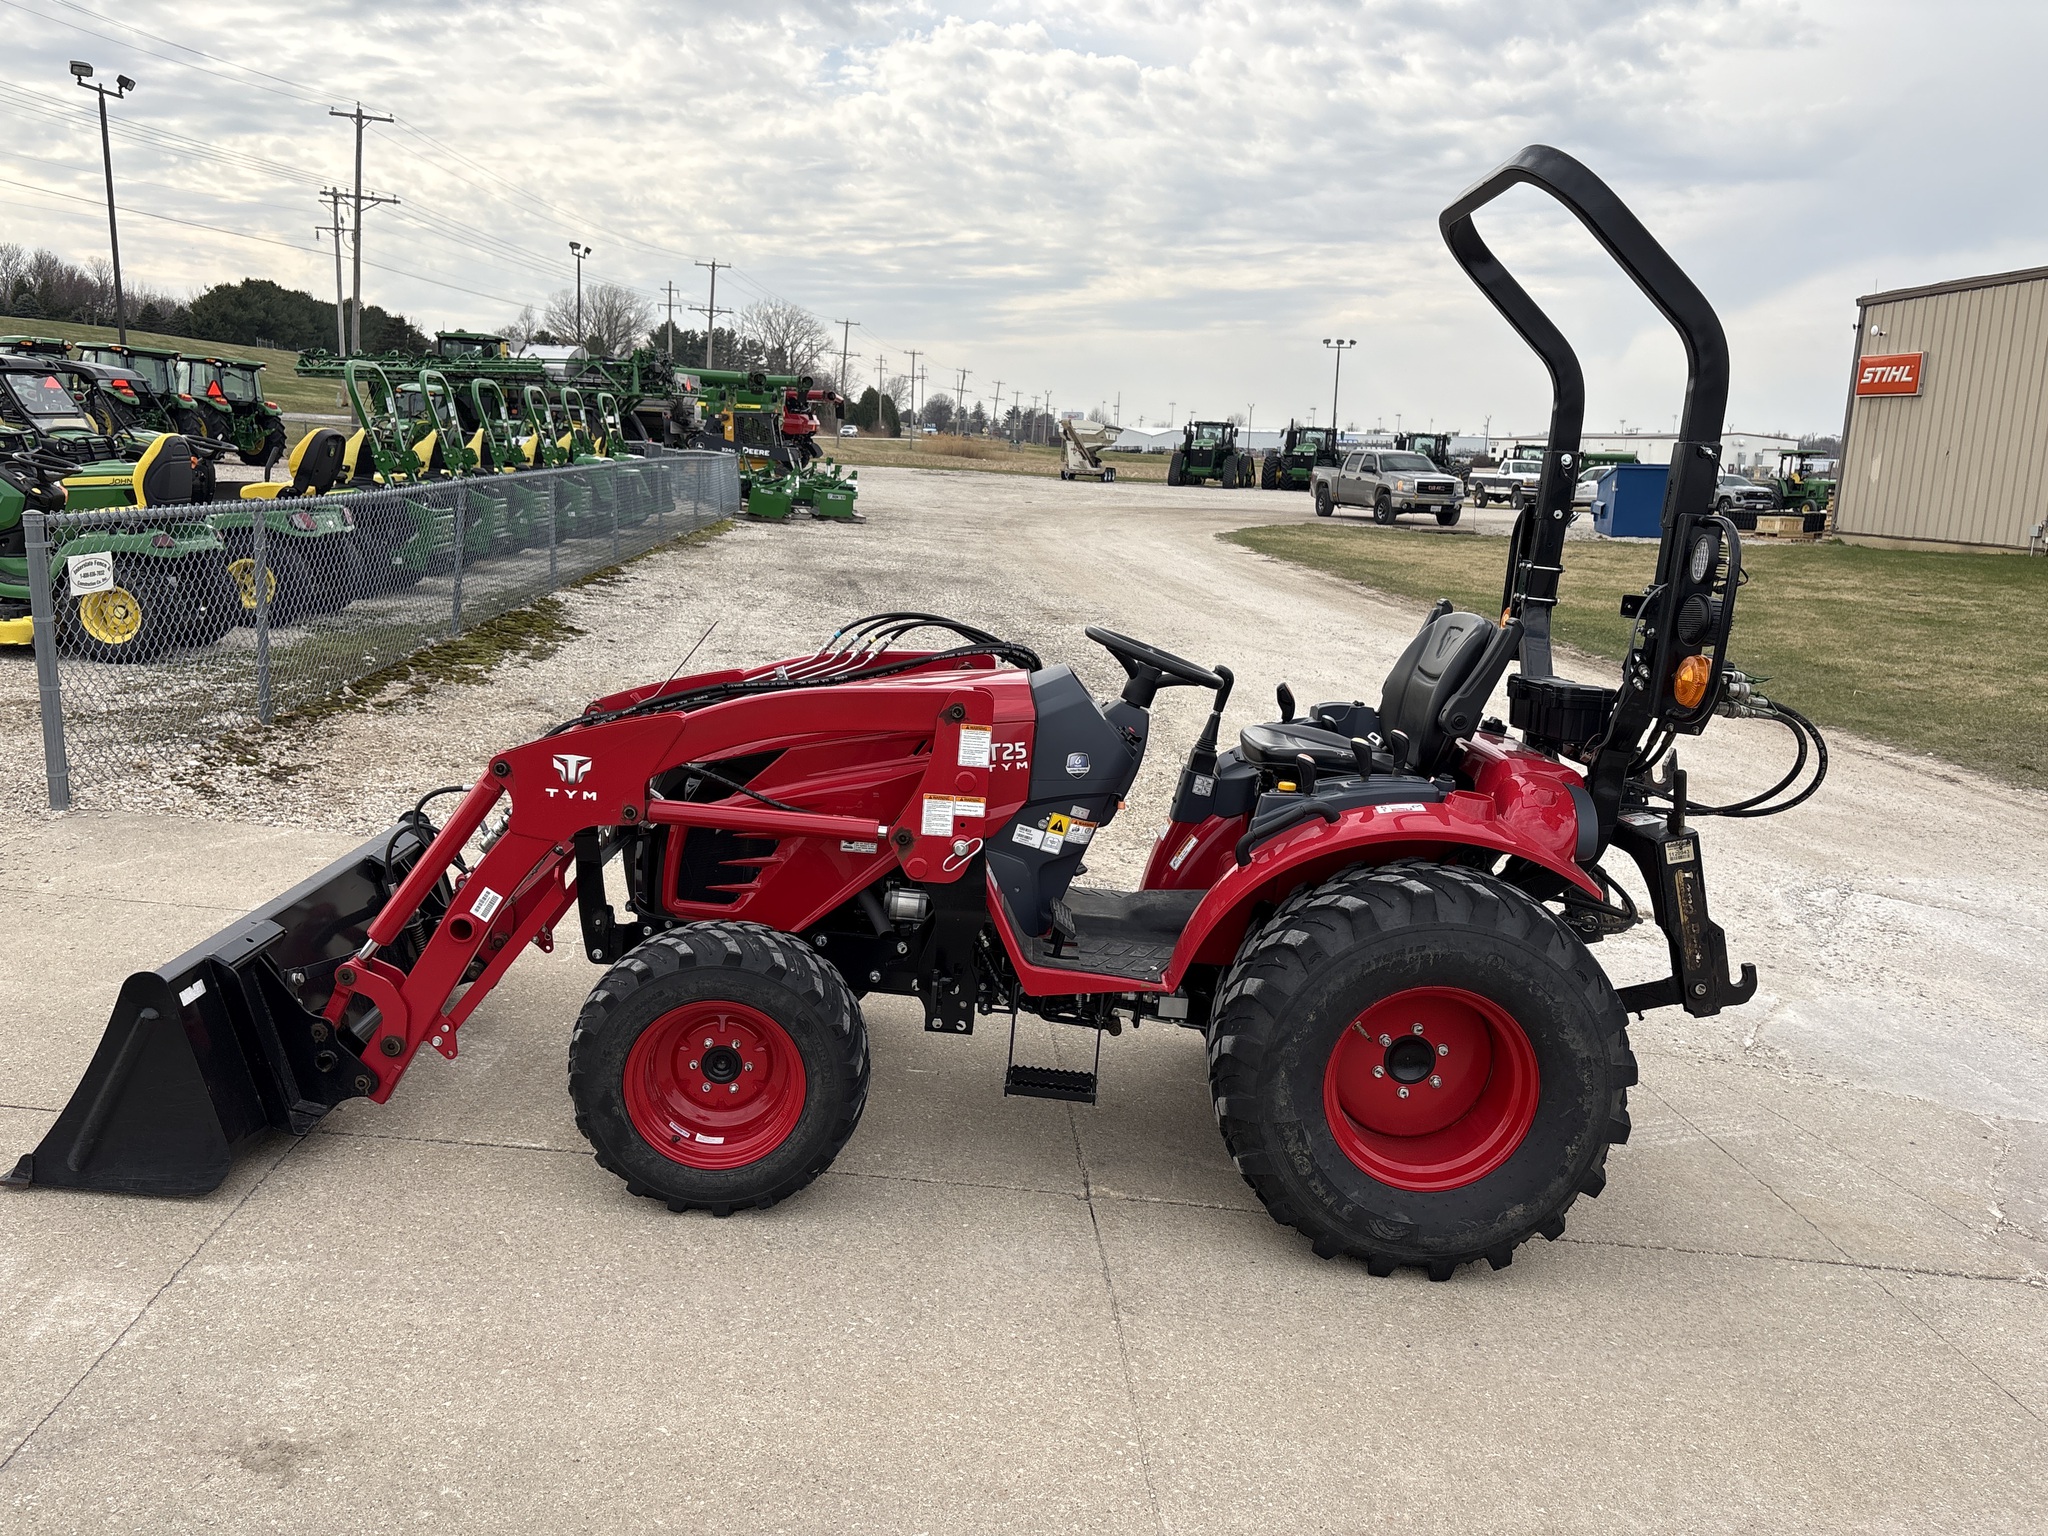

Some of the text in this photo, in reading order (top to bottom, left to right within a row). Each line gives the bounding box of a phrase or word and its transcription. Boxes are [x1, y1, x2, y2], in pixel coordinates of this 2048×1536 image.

[1860, 366, 1913, 384] STIHL
[742, 447, 770, 456] DEERE
[73, 561, 93, 575] Interstate
[94, 560, 107, 568] Fence
[990, 742, 1027, 761] T25
[989, 761, 1028, 772] TYM
[1074, 756, 1082, 764] 6
[545, 788, 597, 801] TYM
